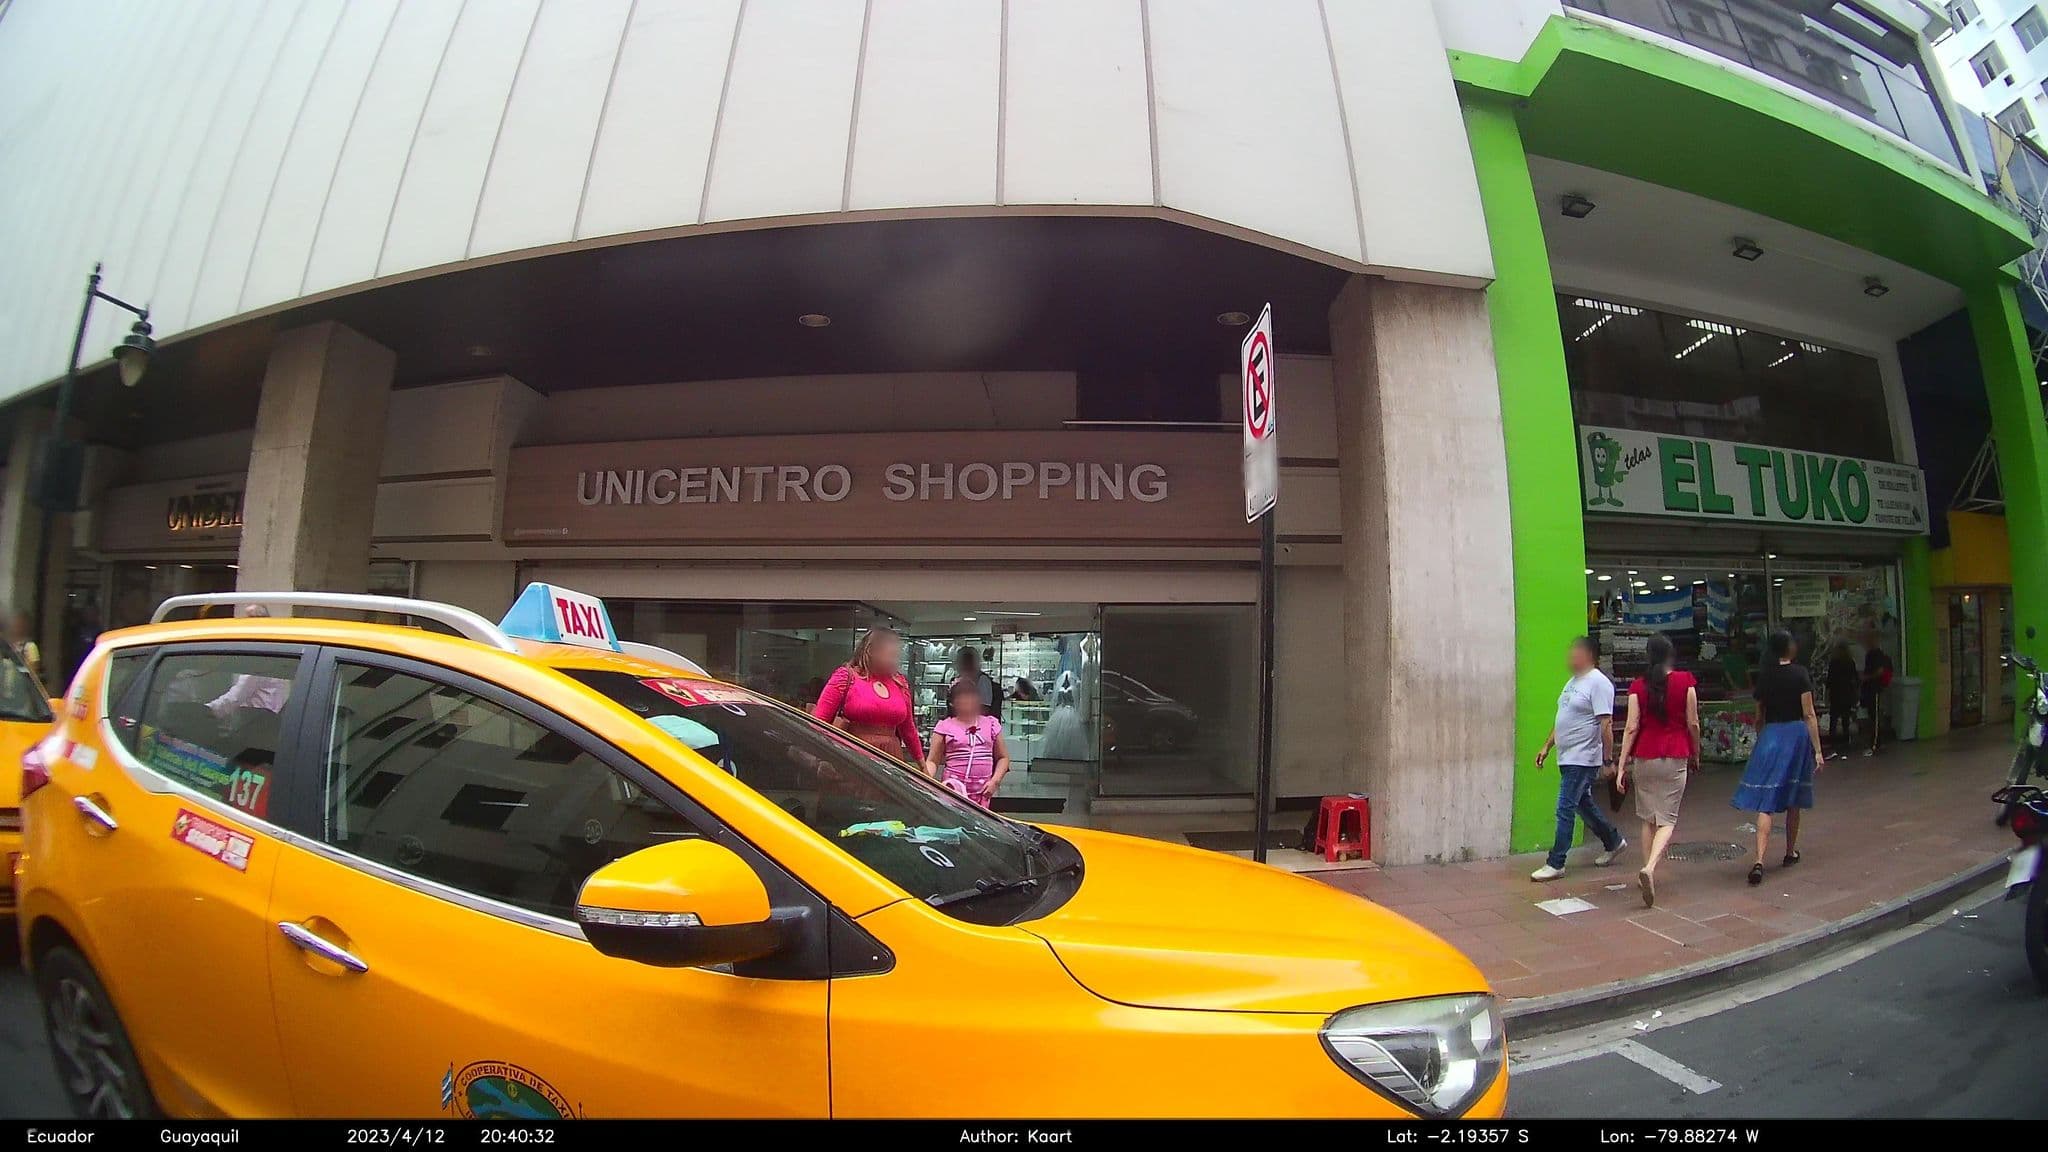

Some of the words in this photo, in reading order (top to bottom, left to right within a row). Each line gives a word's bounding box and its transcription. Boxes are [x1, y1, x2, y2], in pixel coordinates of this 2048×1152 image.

[1624, 446, 1652, 470] telas
[577, 464, 852, 505] UNICENTRO
[882, 462, 1168, 502] SHOPPING
[1657, 437, 1734, 514] EL
[1734, 446, 1870, 525] TUKO
[556, 598, 604, 640] TAXI
[229, 767, 265, 810] 137
[461, 1065, 526, 1087] COOPERATIVA
[529, 1077, 545, 1092] DE
